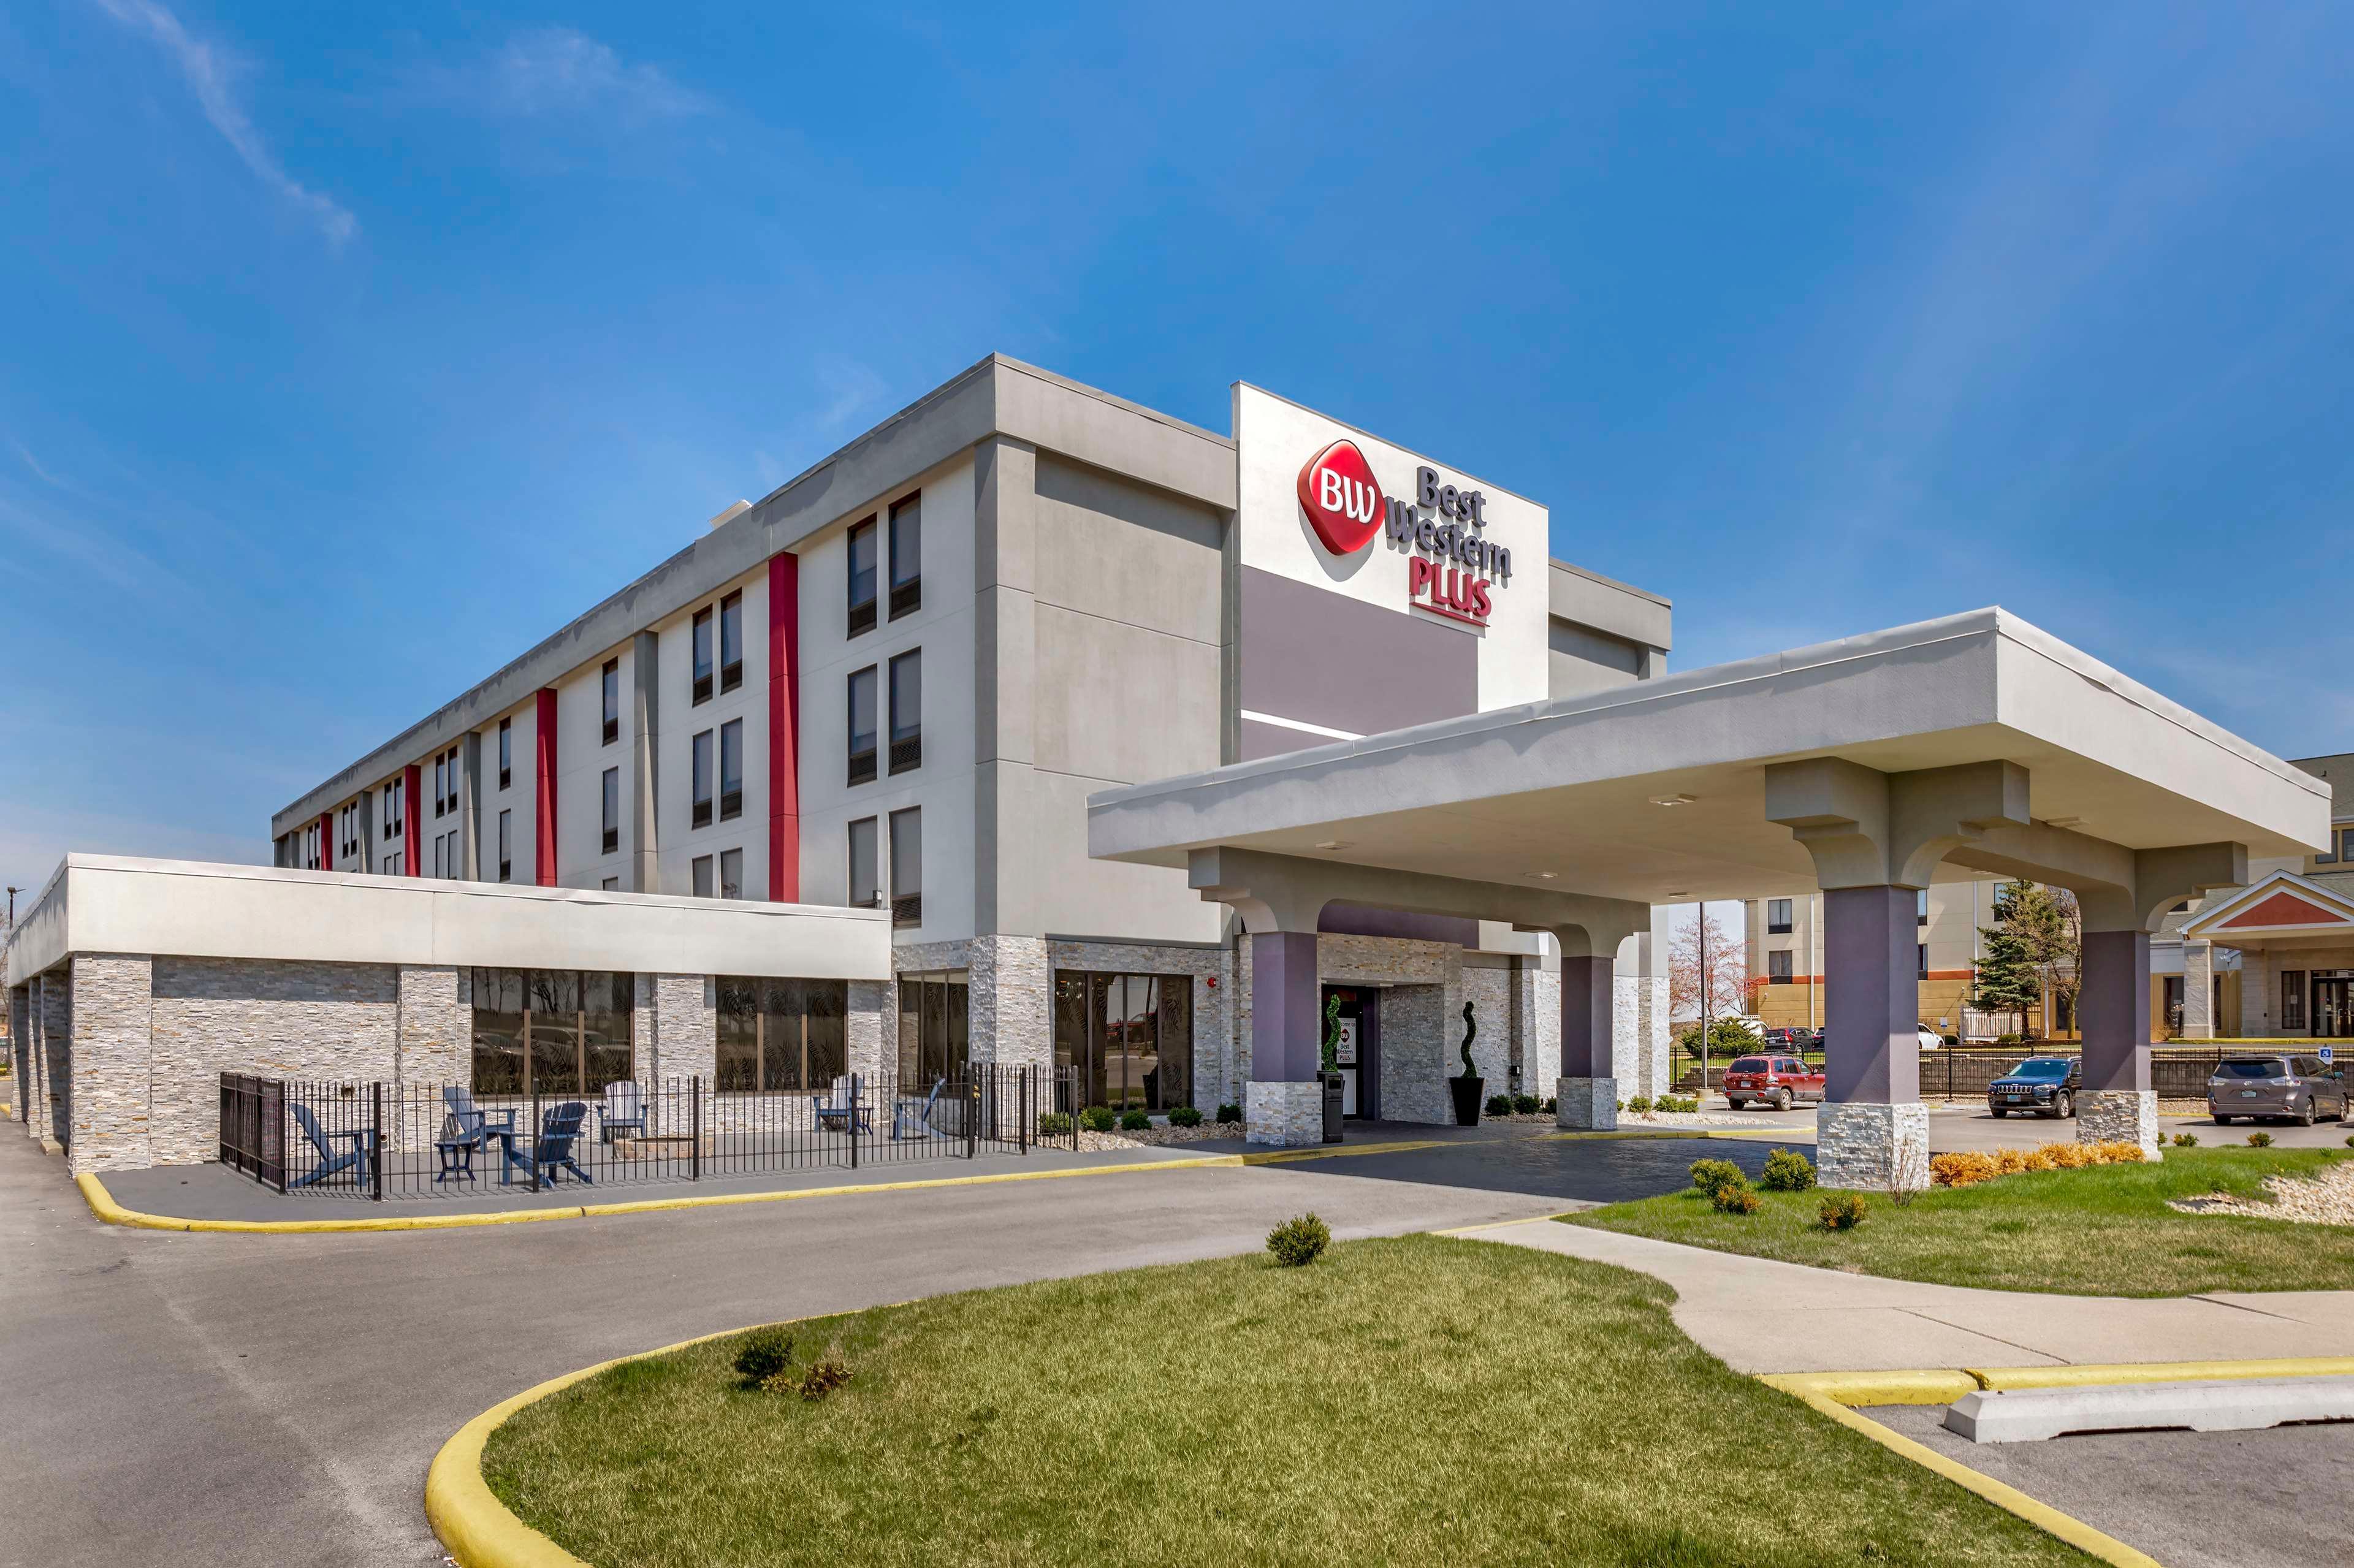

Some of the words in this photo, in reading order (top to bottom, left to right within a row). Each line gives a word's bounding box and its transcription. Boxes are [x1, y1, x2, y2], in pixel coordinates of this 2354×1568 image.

[1320, 467, 1376, 524] BW
[1416, 466, 1487, 528] Best
[1384, 496, 1513, 578] Western
[1409, 556, 1491, 617] PLUS
